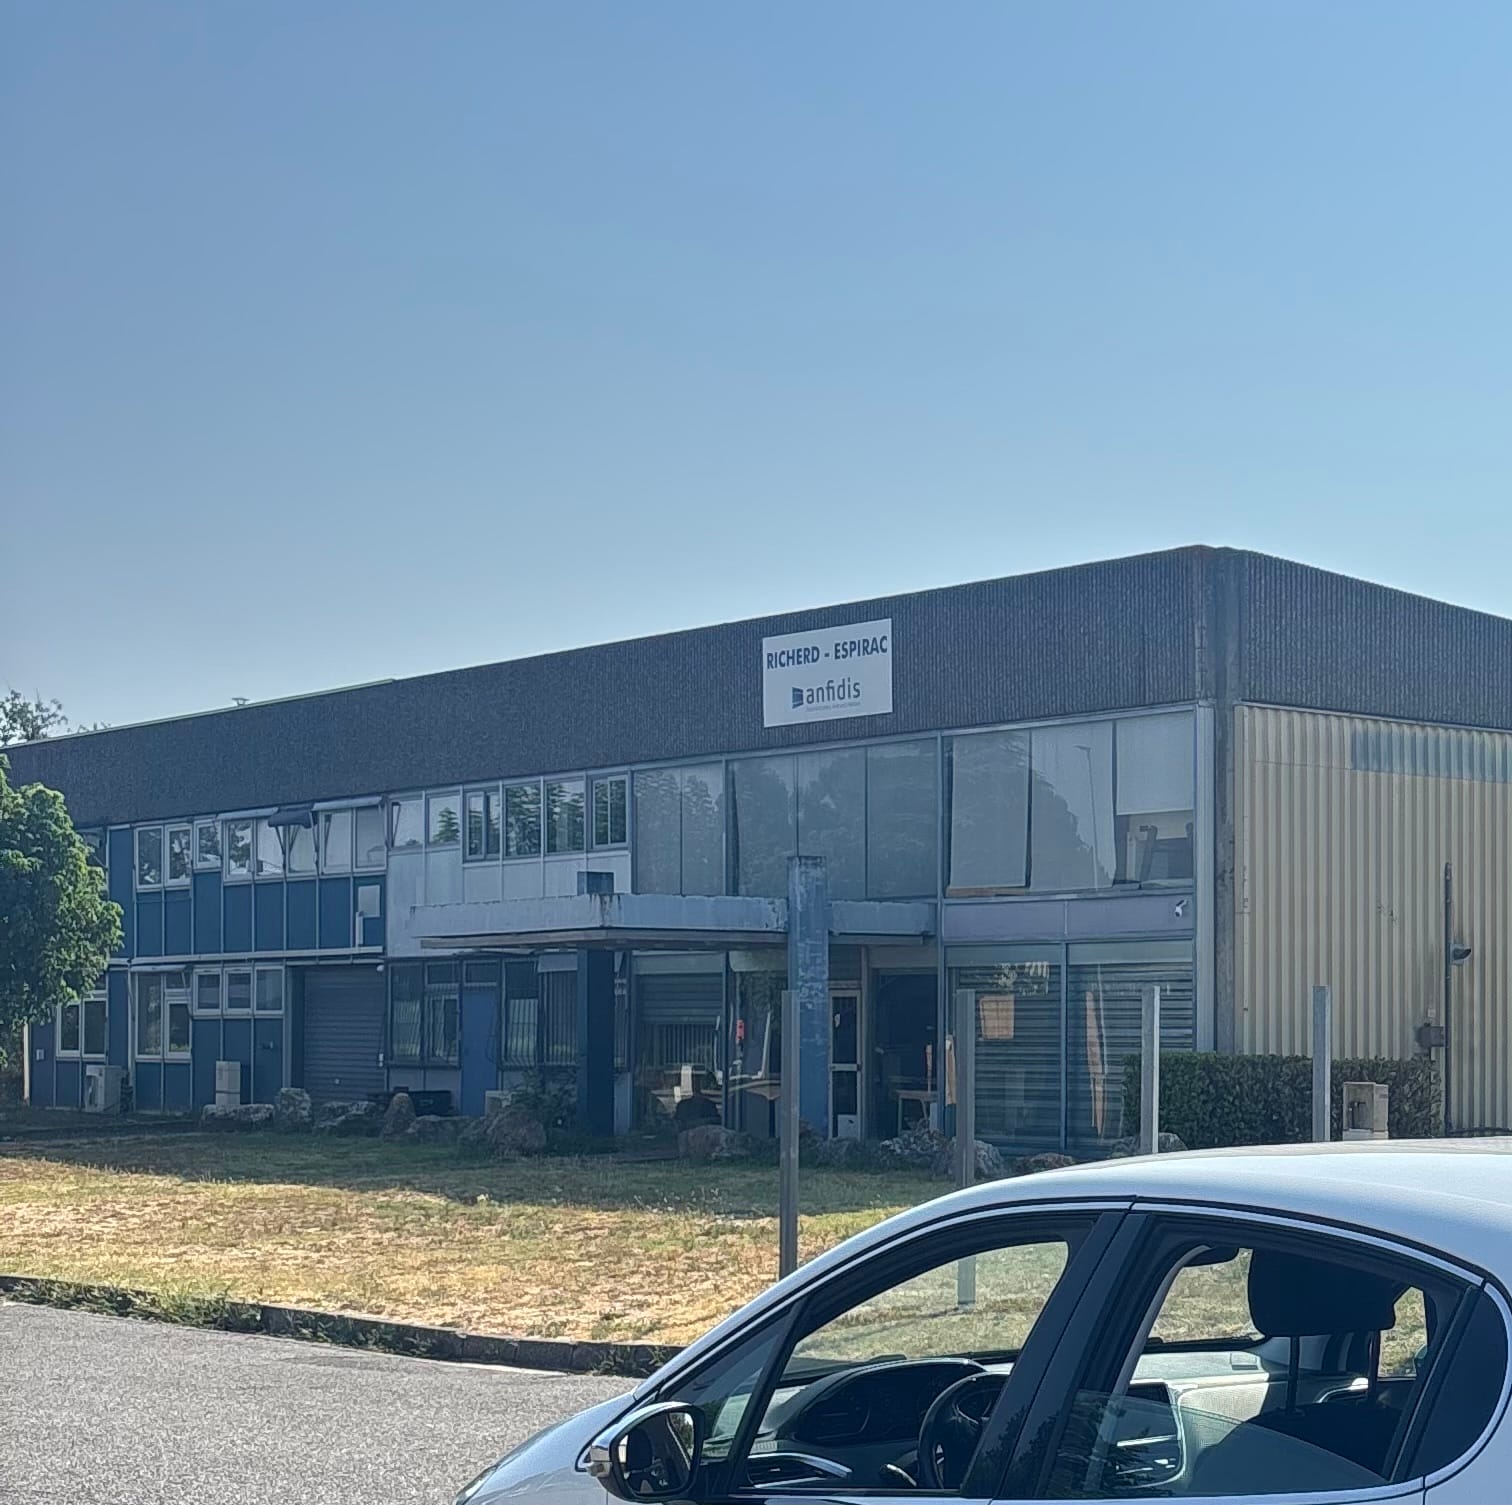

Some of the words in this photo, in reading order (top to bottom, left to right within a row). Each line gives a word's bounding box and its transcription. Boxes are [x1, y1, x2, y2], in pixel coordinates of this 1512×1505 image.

[766, 645, 820, 670] RICHERD
[834, 635, 888, 660] ESPIRAC
[806, 677, 861, 705] anfidis
